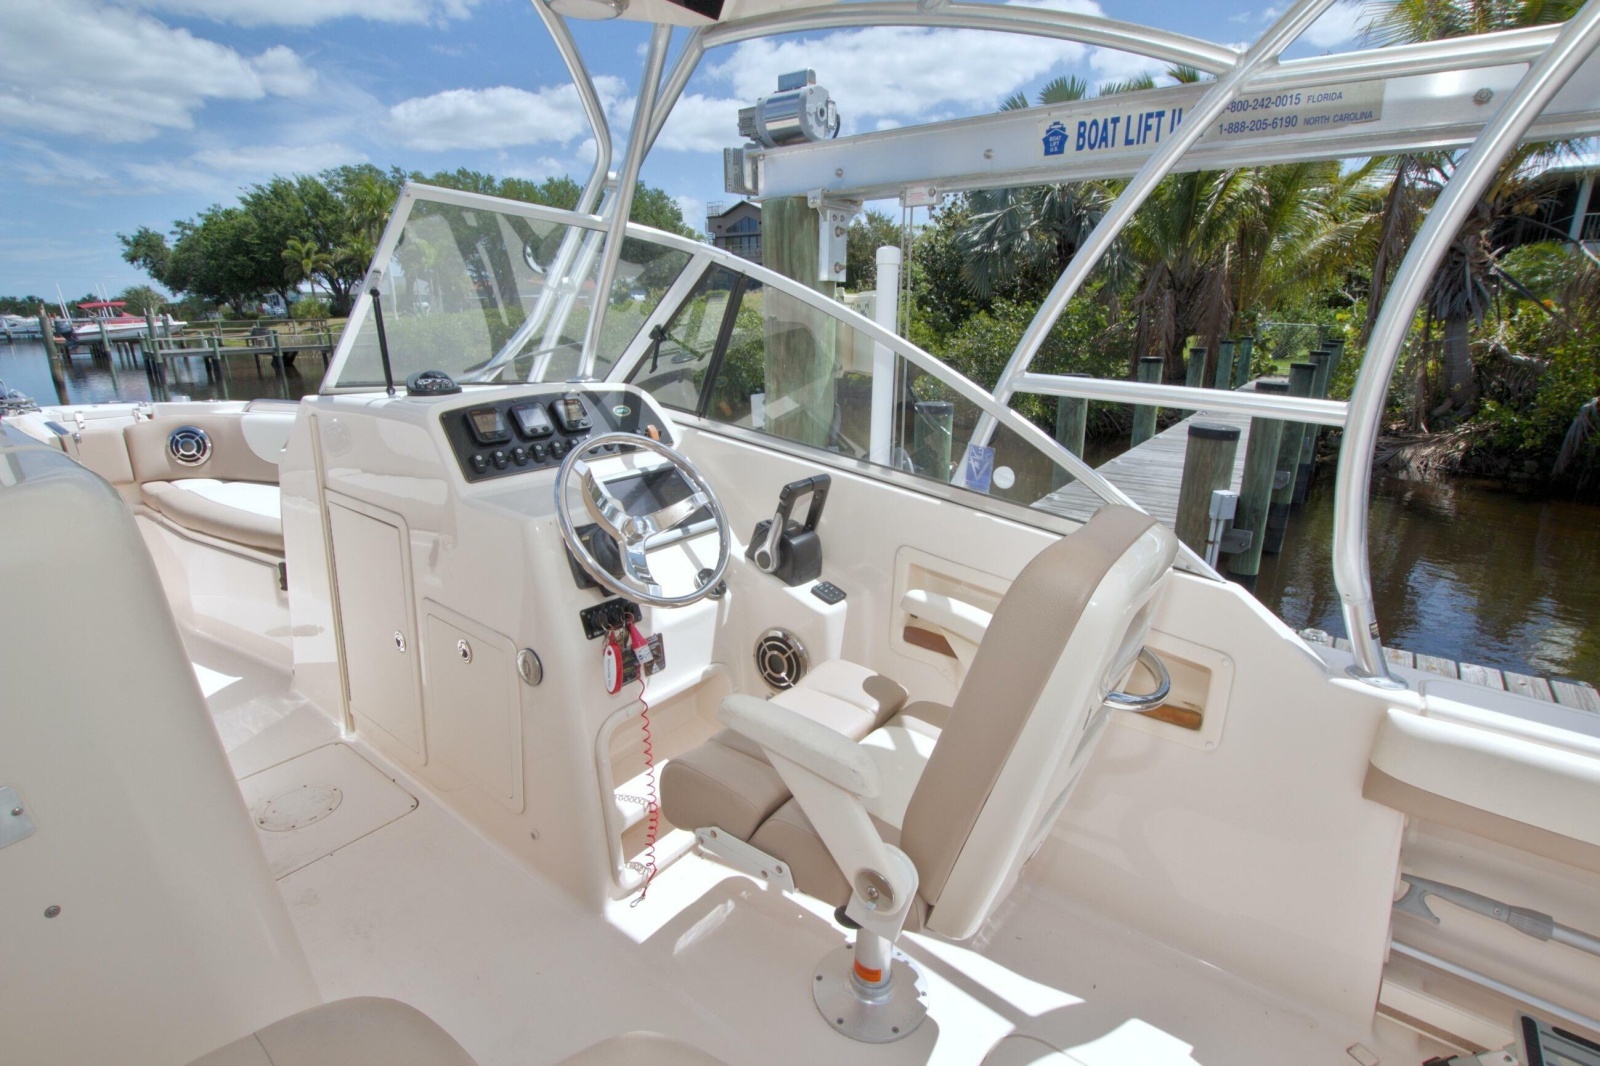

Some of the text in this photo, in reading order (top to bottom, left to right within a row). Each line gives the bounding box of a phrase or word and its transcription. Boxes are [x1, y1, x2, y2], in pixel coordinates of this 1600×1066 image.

[1307, 91, 1342, 104] FLORIDA
[1076, 116, 1121, 151] BOAT
[1124, 110, 1166, 146] LIFT
[1218, 110, 1373, 135] 1-888-205-6190 NORTH CAROLINA
